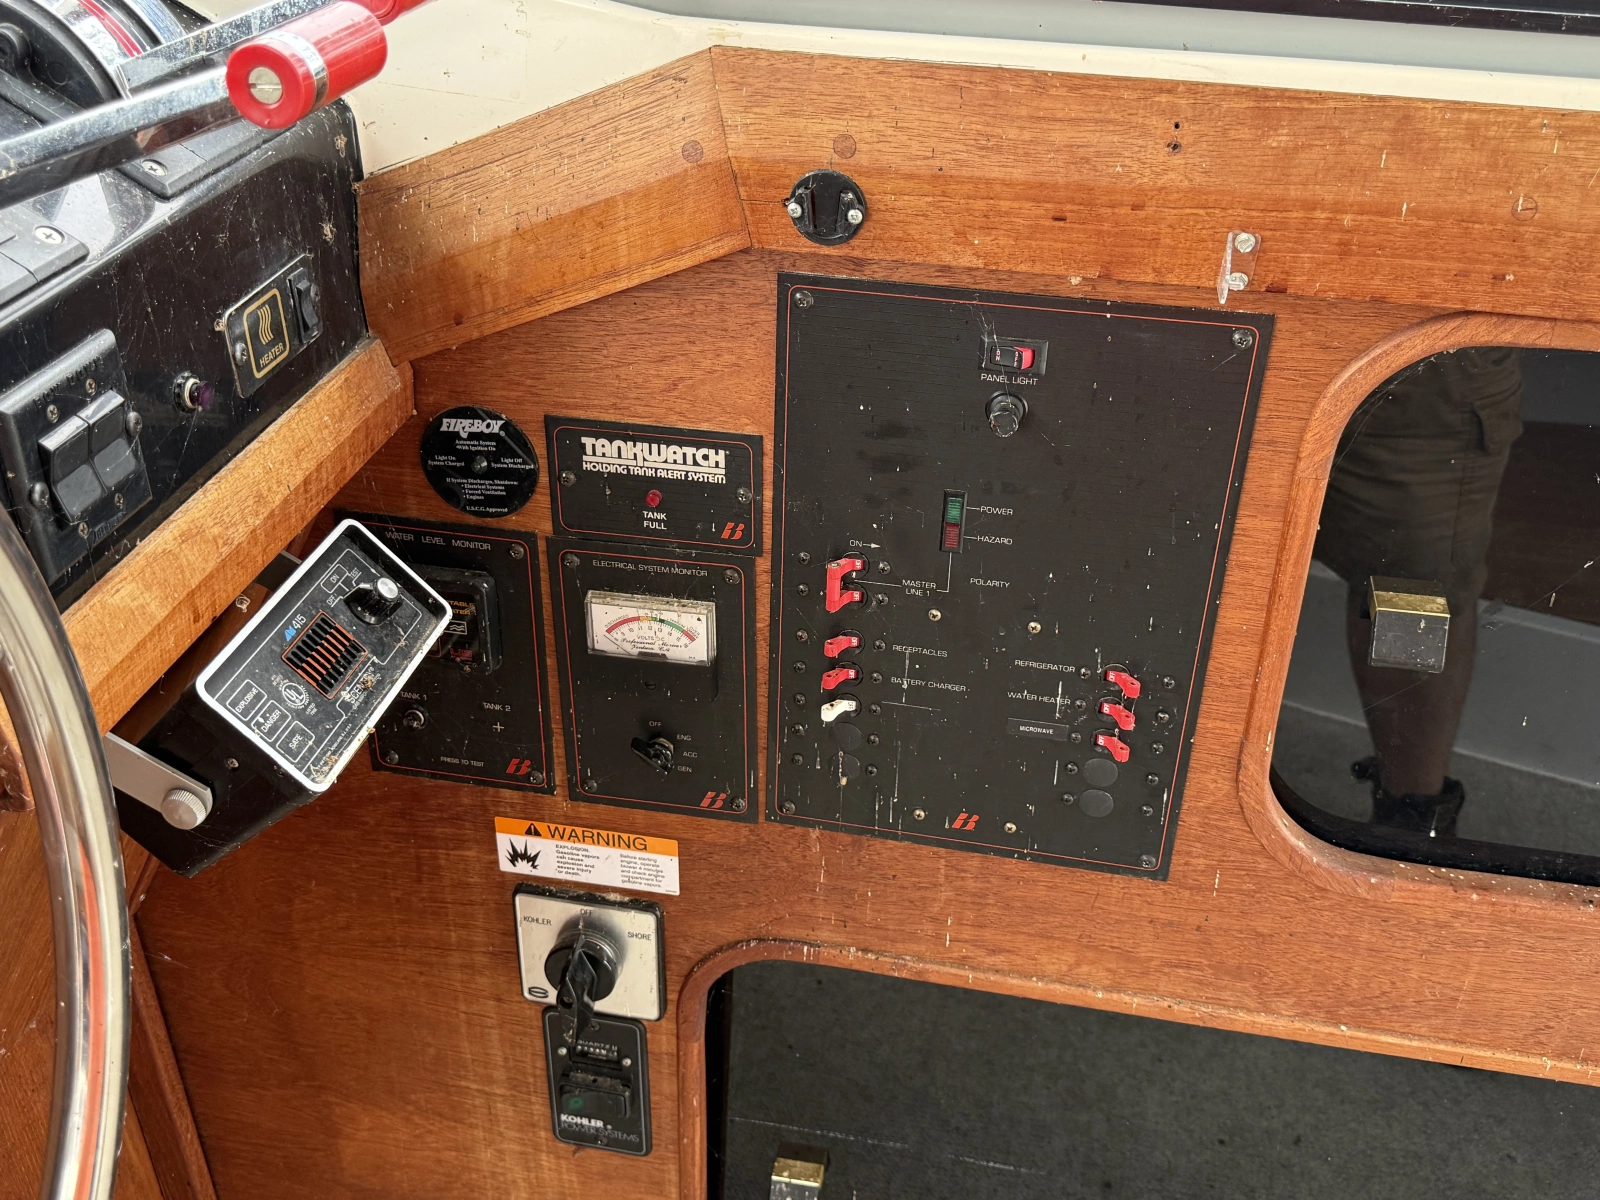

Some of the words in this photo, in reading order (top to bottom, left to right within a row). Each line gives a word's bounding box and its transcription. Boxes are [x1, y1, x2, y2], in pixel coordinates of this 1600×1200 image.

[260, 342, 284, 367] HEATER
[981, 374, 1010, 384] PANEL
[1012, 377, 1038, 386] LIGHT
[440, 418, 505, 438] FIREBOY
[581, 436, 726, 468] TANKWATCH
[582, 462, 628, 475] HOLDING
[630, 466, 656, 478] TANK
[656, 468, 686, 481] ALERT
[687, 472, 726, 484] SYSTEM
[642, 510, 667, 520] TANK
[980, 506, 1013, 516] POWER
[644, 520, 667, 530] FULL
[386, 531, 414, 542] WATER
[422, 536, 446, 546] LEVEL
[452, 539, 492, 550] MONITOR
[978, 534, 1013, 545] HAZARD
[350, 567, 360, 578] TEST
[592, 560, 636, 571] ELECTRICAL
[638, 564, 670, 574] SYSTEM
[672, 567, 708, 577] MONITOR
[330, 574, 340, 584] ON
[902, 580, 936, 590] MASTER
[970, 578, 1010, 588] POLARITY
[906, 588, 924, 596] LINE
[326, 595, 336, 606] OFF
[292, 614, 306, 629] 415
[892, 644, 948, 658] RECEPTACLES
[1014, 660, 1076, 672] REFRIGERATOR
[891, 676, 926, 687] BATTERY
[928, 680, 966, 692] CHARGER
[235, 687, 258, 713] EXPLOSIVE
[400, 690, 420, 700] TANK
[1008, 692, 1038, 701] WATER
[1039, 694, 1070, 705] HEATER
[483, 702, 503, 711] TANK
[261, 710, 282, 732] DANGER
[1020, 726, 1054, 734] MICROWAVE
[288, 734, 303, 750] SAFE
[440, 756, 460, 764] PRESS
[546, 825, 648, 851] WARNING
[580, 908, 594, 916] OFF
[523, 916, 552, 926] KOHLER
[628, 932, 652, 940] SHORE
[560, 1114, 604, 1128] KOHLER
[560, 1120, 597, 1134] POWER
[599, 1127, 640, 1142] SYSTEMS
